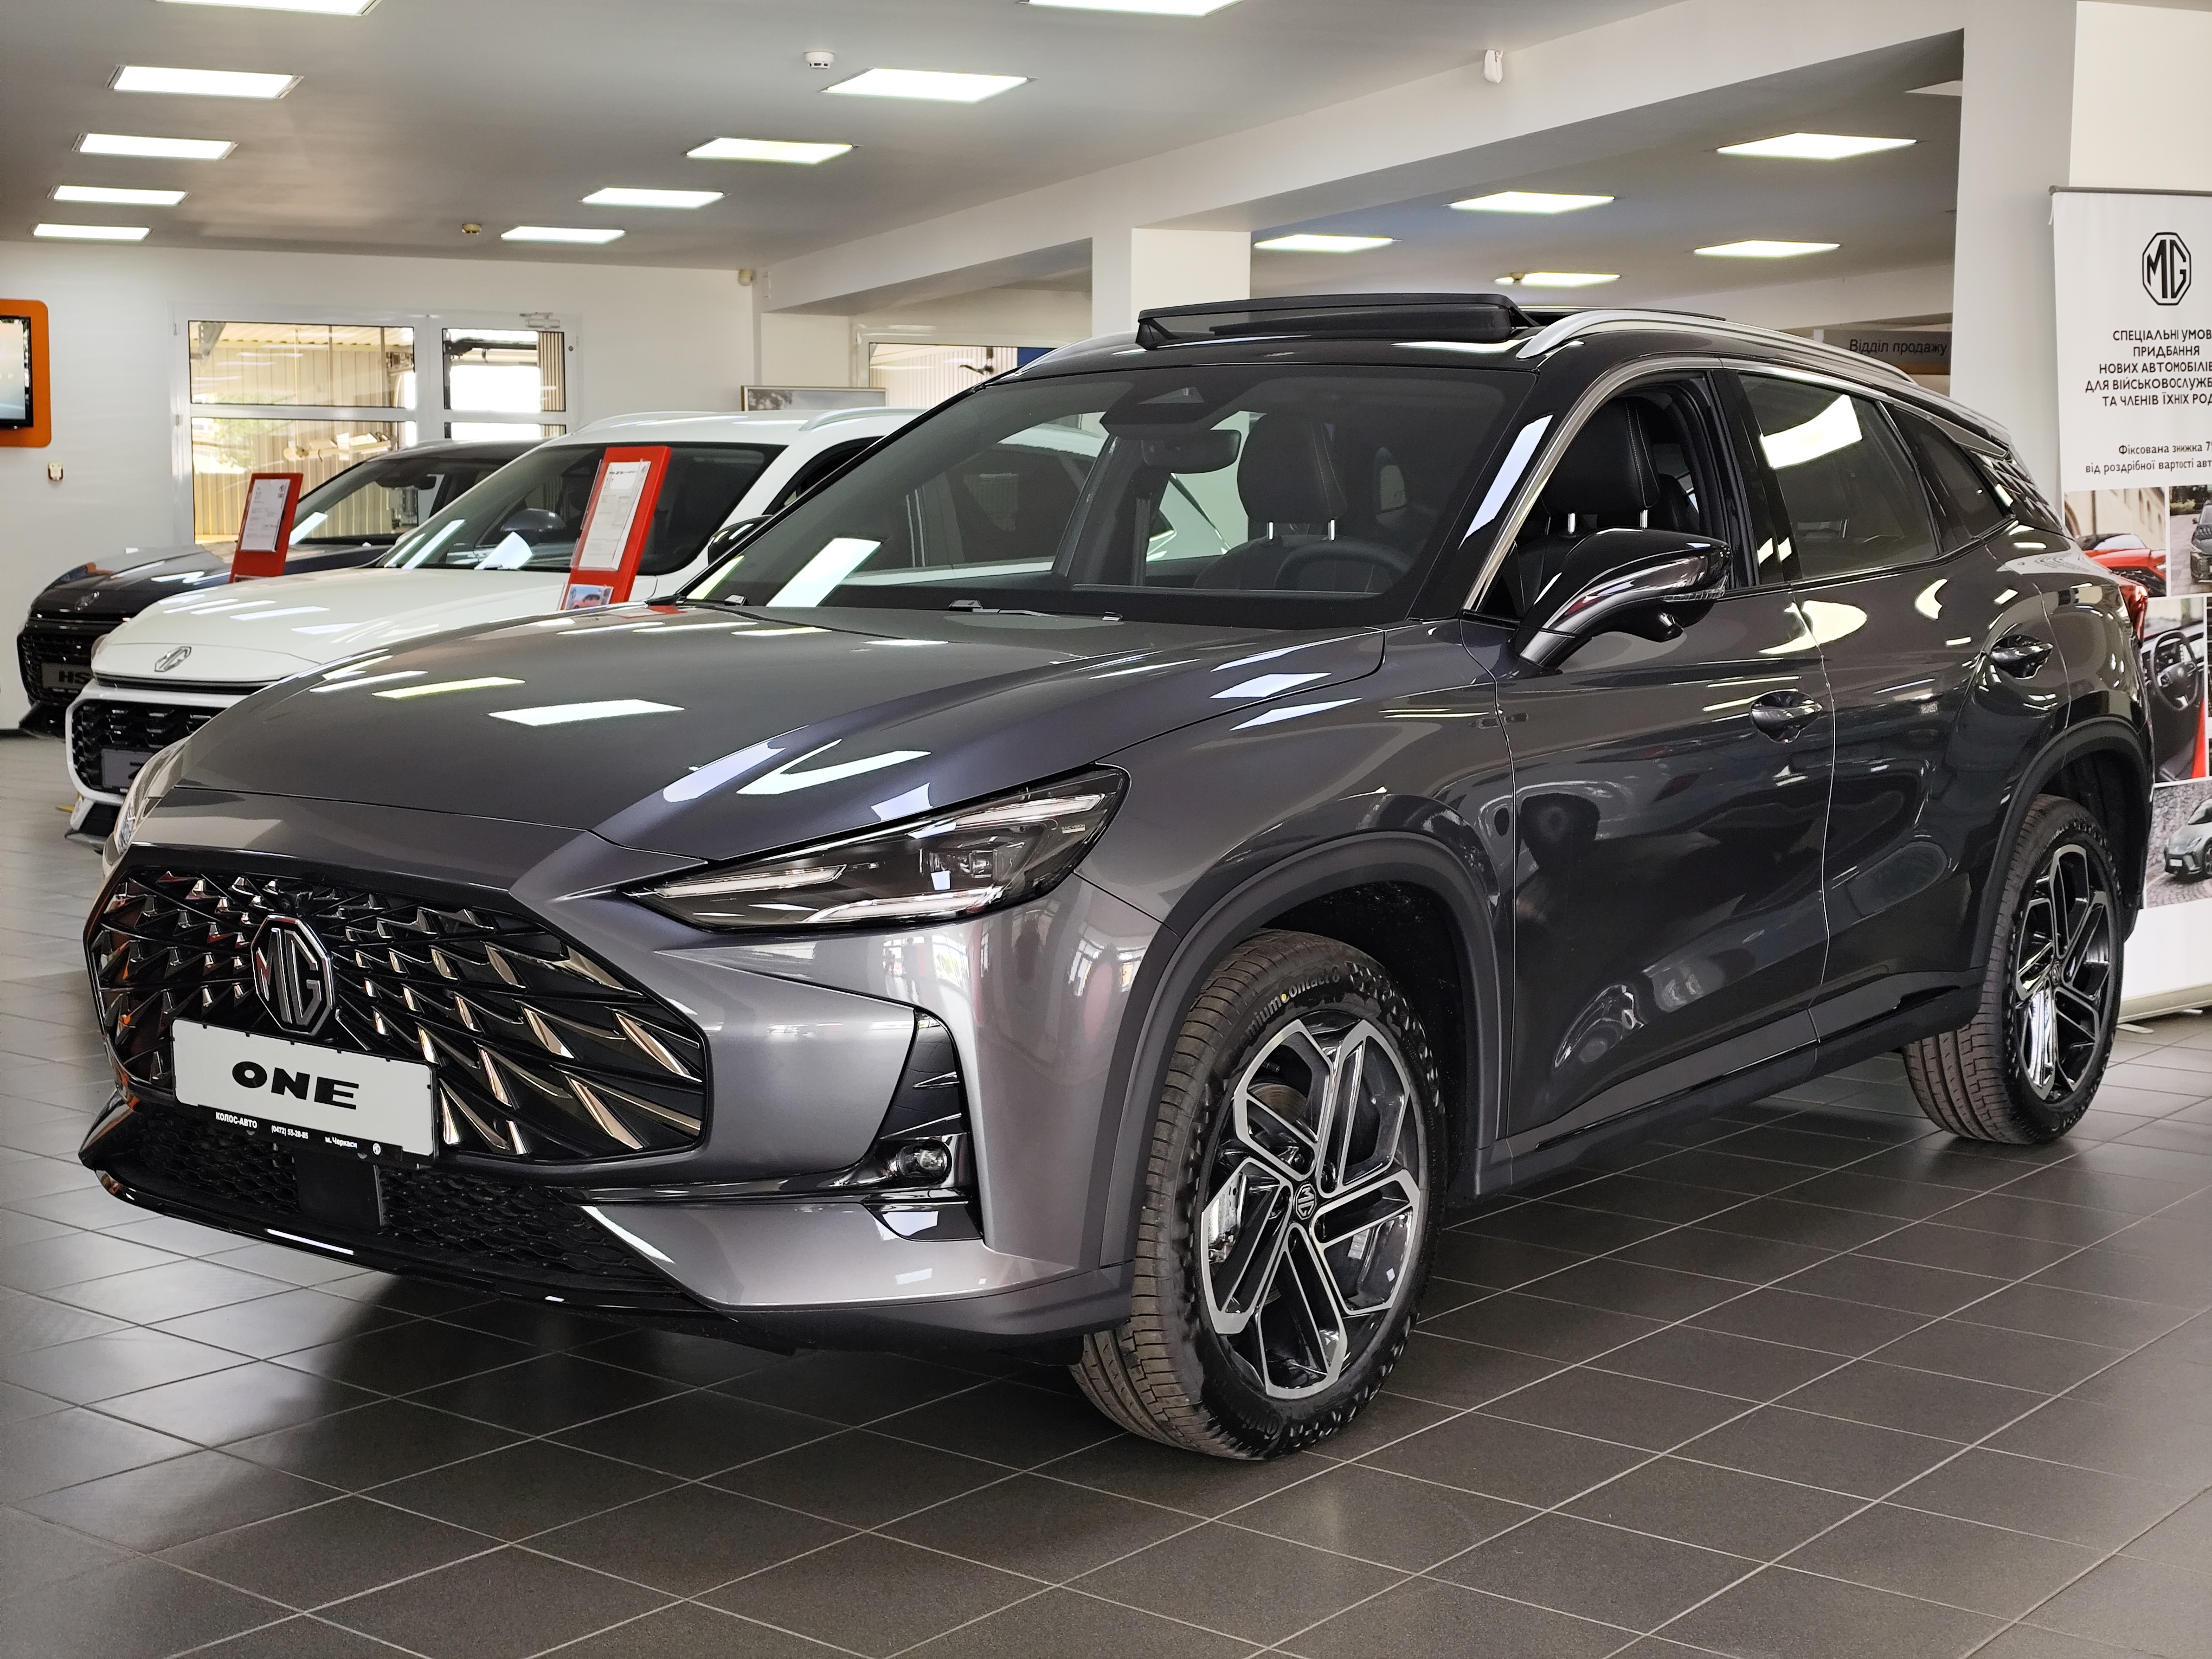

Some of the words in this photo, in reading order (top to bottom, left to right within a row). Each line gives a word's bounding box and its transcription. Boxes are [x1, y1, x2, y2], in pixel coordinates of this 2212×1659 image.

[2146, 239, 2187, 300] MG
[2113, 330, 2179, 343] СПЕЦІАЛЬНІ
[1849, 339, 1888, 354] Відділ
[1893, 342, 1947, 356] продажу
[2133, 345, 2200, 358] ПРИДБАННЯ
[2099, 363, 2139, 374] НОВИХ
[2142, 361, 2212, 372] АВТОМОБІЛІВ
[2085, 380, 2109, 393] ДЛЯ
[2102, 396, 2117, 407] ТА
[2120, 395, 2159, 406] ЧЛЕНІВ
[2162, 391, 2189, 404] ЇХНІХ
[2118, 444, 2170, 455] Фіксована
[2172, 444, 2203, 453] знижка
[2205, 441, 2212, 451] 7
[2086, 462, 2101, 474] від
[2104, 460, 2156, 475] роздрібної
[2158, 458, 2194, 472] вартості
[59, 671, 93, 684] HS
[255, 927, 323, 1027] MG
[232, 1061, 359, 1110] ONE
[215, 1111, 258, 1129] КОЛОС-АВТО
[271, 1124, 287, 1136] (0472)
[1297, 1186, 1315, 1218] MG
